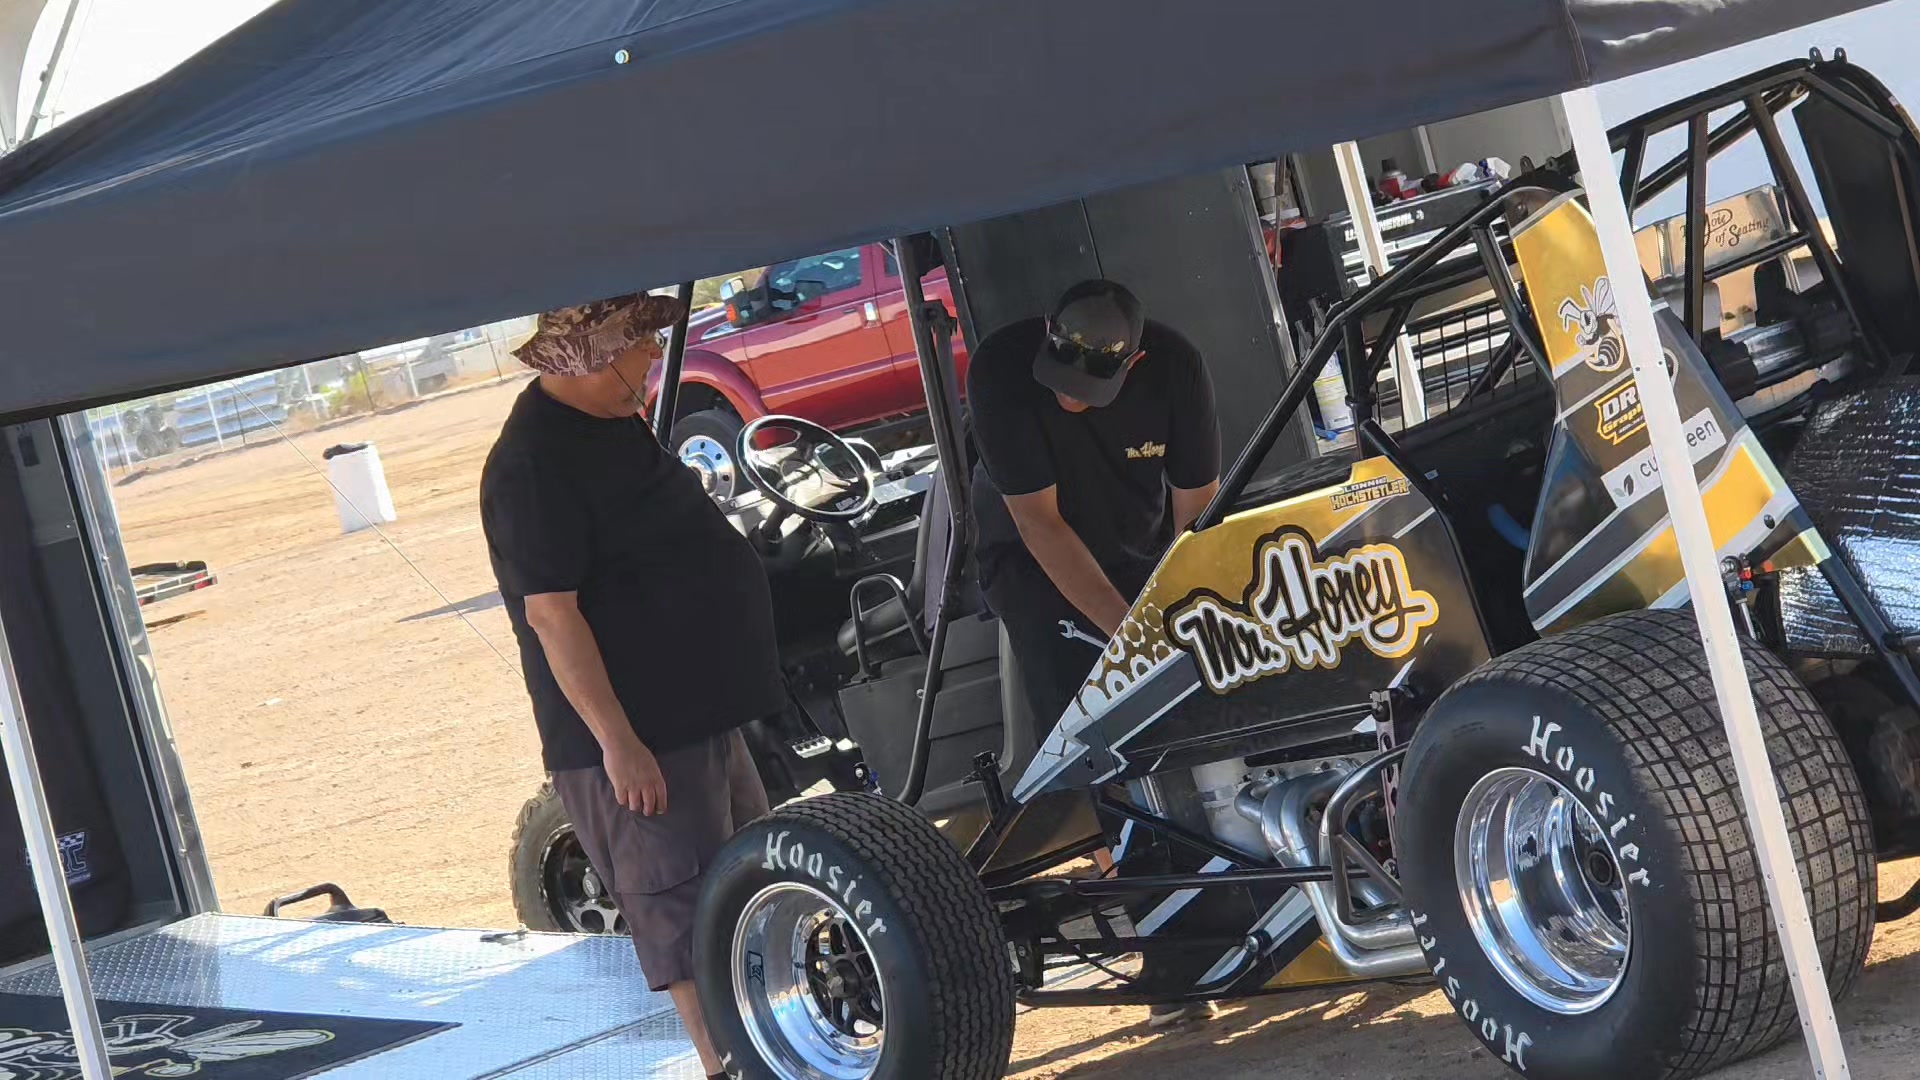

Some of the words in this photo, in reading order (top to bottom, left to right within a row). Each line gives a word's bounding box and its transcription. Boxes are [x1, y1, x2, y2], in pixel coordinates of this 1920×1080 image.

[1715, 230, 1728, 247] of
[1728, 217, 1769, 247] Seating
[1602, 386, 1641, 422] DR
[1330, 478, 1408, 511] HOCHSTETLER
[1343, 476, 1388, 493] LONNIE
[1176, 603, 1286, 688] Mr.
[1257, 543, 1430, 662] Honey
[1521, 715, 1650, 888] Hoosier
[761, 830, 888, 938] Hoosier
[1410, 908, 1535, 1072] Hoosier
